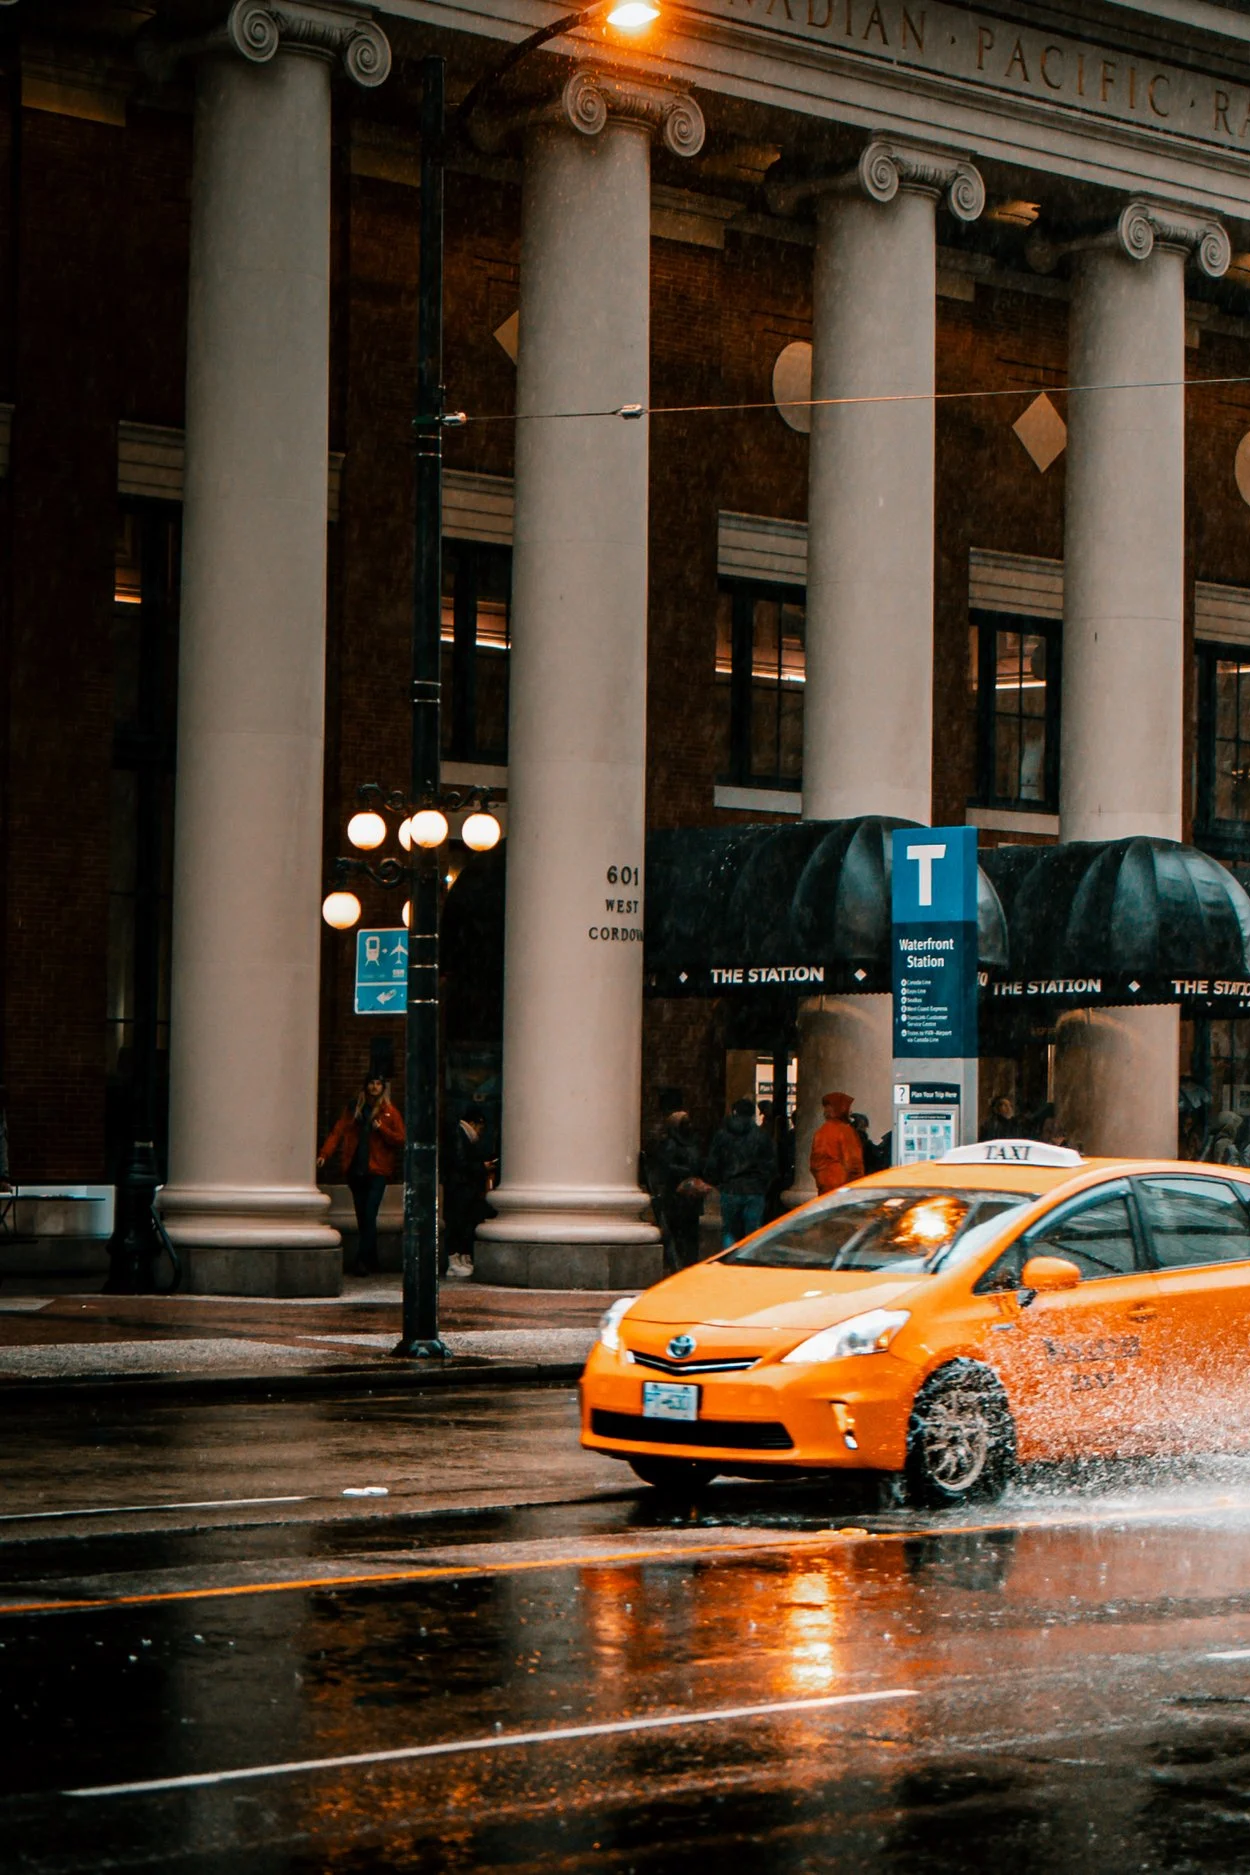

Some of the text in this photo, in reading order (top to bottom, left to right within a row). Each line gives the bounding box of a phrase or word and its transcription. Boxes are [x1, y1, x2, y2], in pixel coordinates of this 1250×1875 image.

[977, 26, 1170, 117] PACIFIC
[606, 865, 639, 886] 601
[906, 844, 947, 906] T
[605, 899, 639, 913] WEST
[899, 938, 954, 951] Waterfront
[907, 955, 945, 968] Station
[711, 966, 825, 983] THE STATION
[992, 978, 1102, 996] THE STATION
[1171, 979, 1208, 995] THE
[984, 1145, 1032, 1161] TAXI
